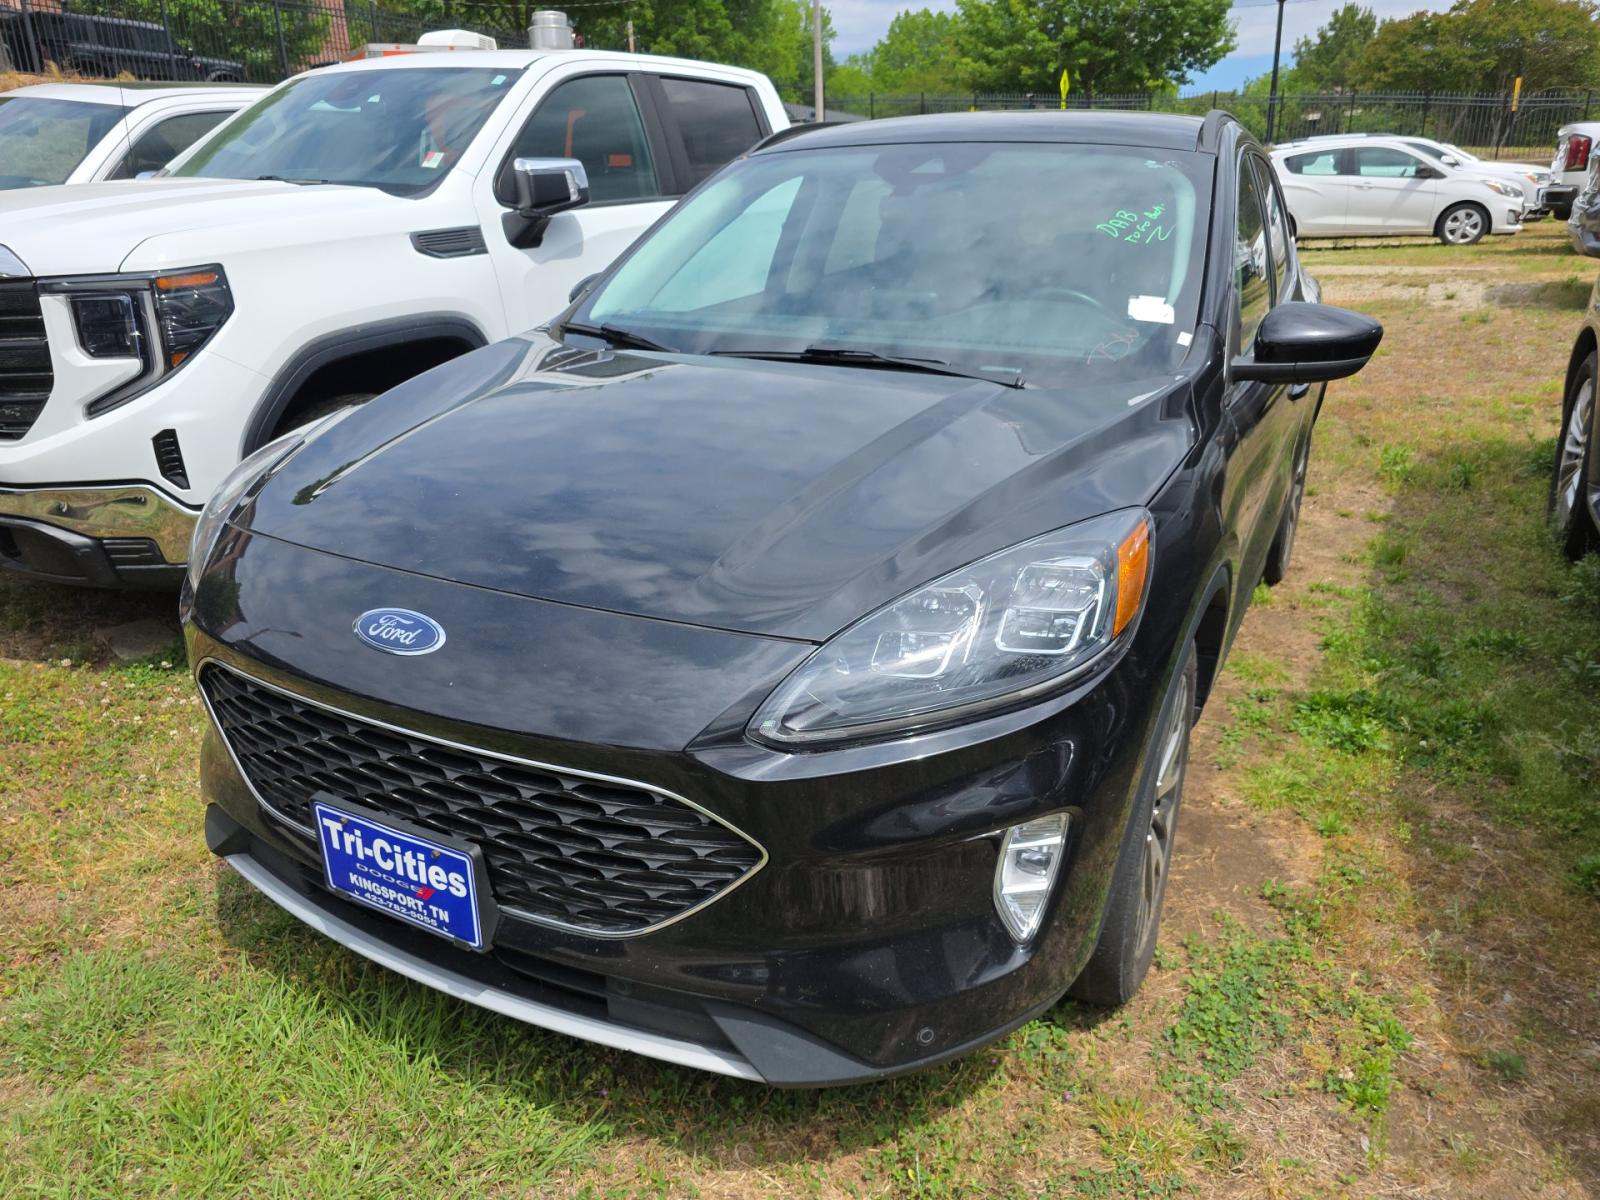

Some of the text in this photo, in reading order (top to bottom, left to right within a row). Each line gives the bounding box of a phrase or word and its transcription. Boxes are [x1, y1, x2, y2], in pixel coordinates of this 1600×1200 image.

[369, 614, 423, 645] Ford
[322, 817, 468, 898] Tri-Cities
[350, 872, 450, 923] KINGSPORT, TN
